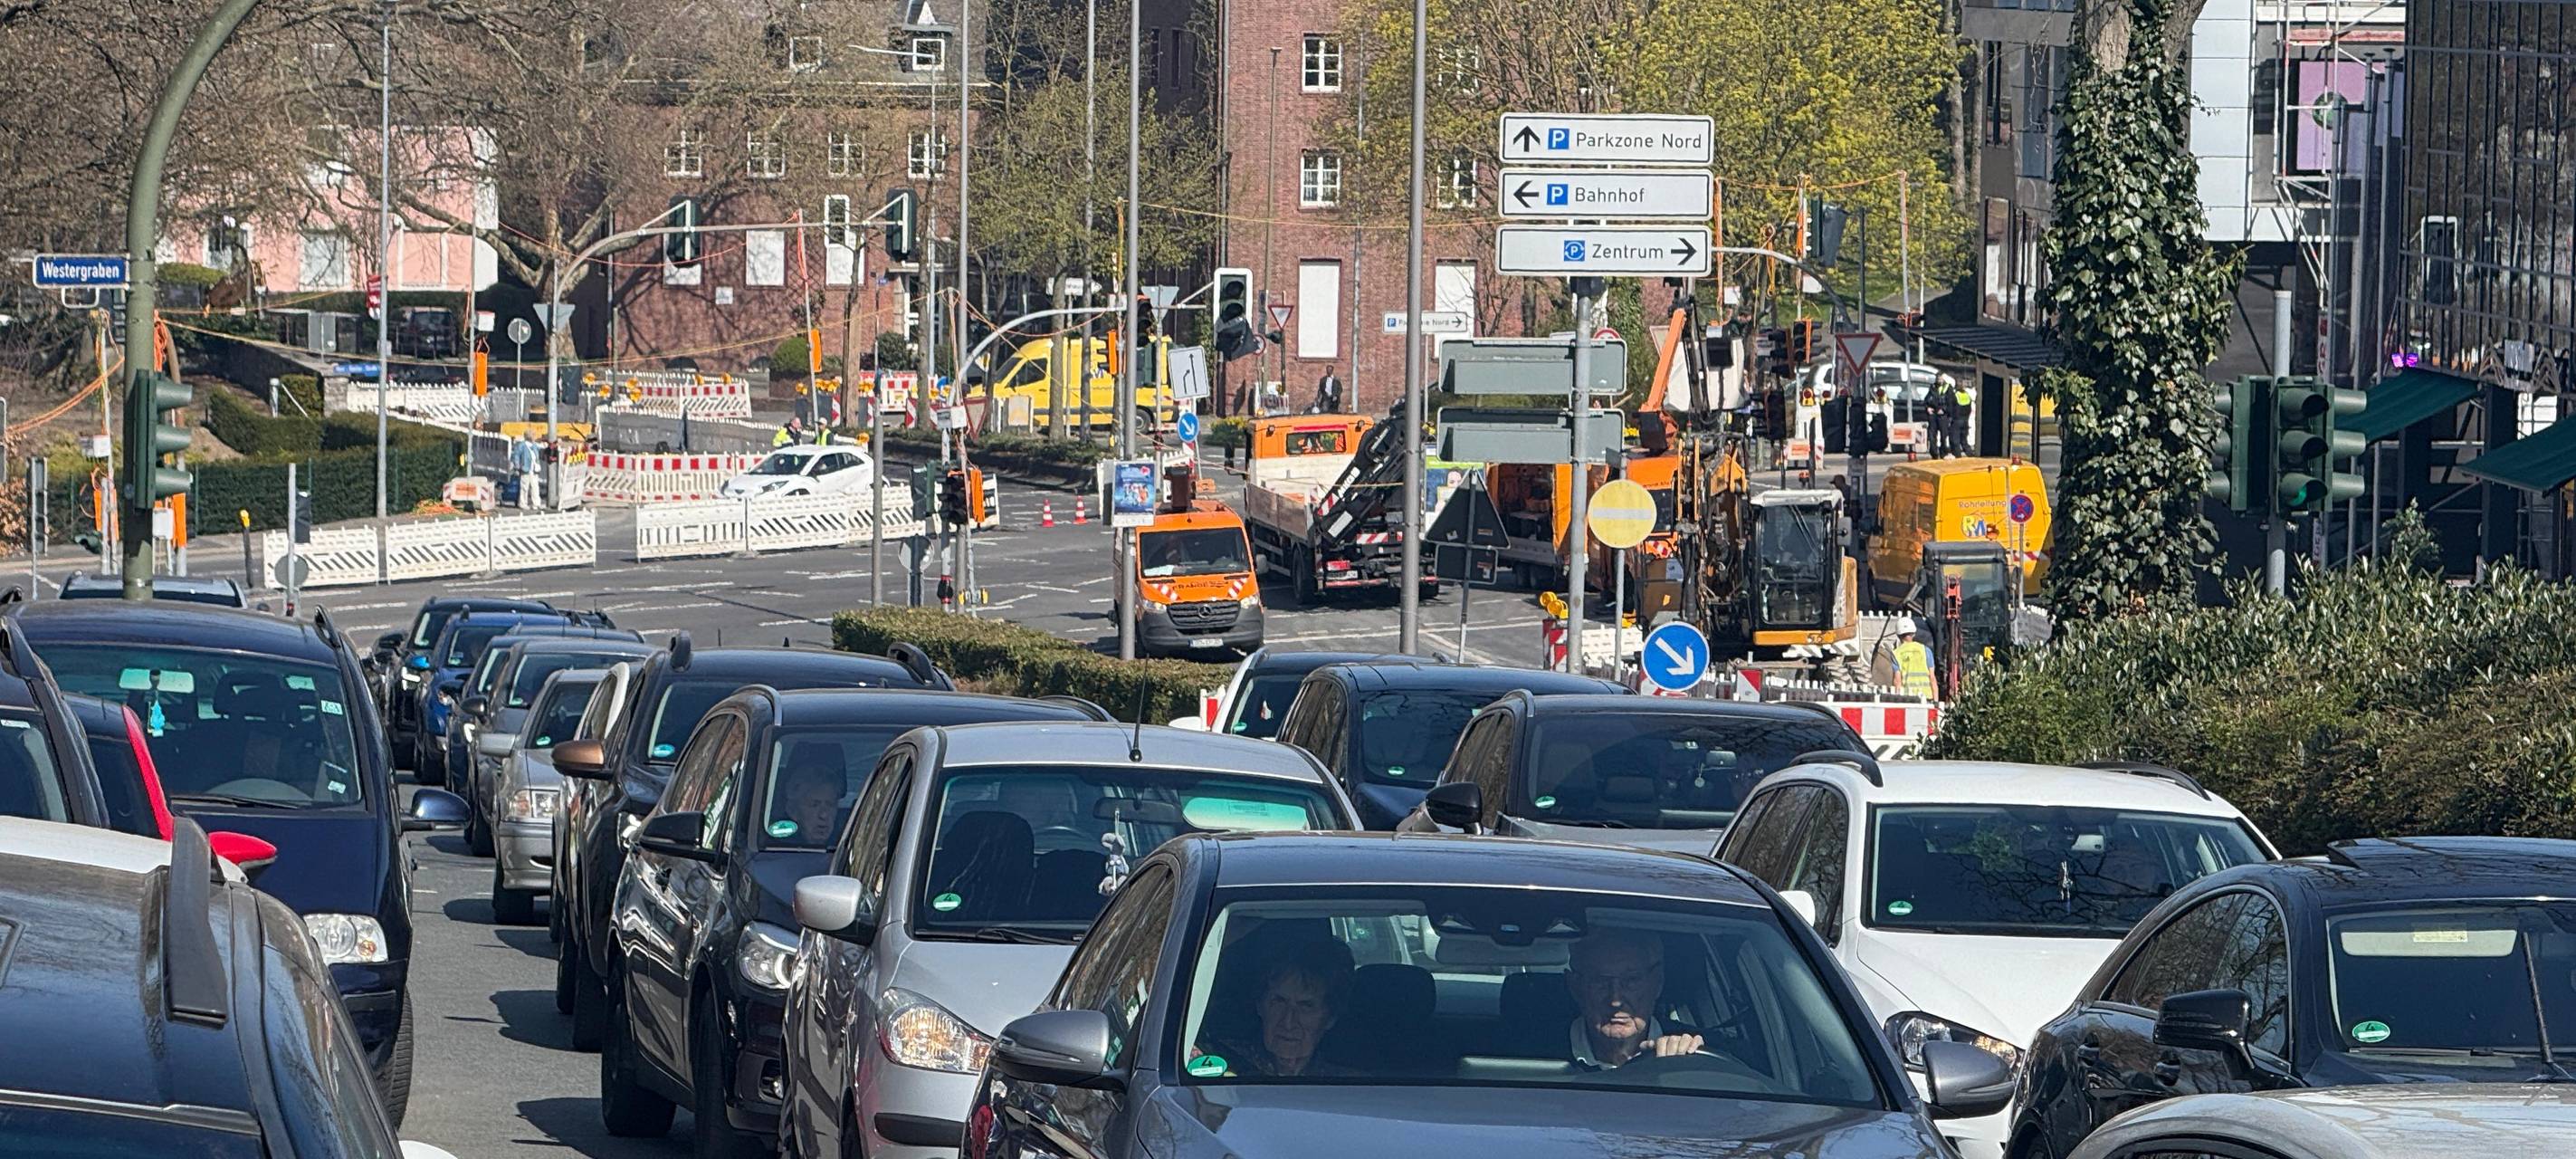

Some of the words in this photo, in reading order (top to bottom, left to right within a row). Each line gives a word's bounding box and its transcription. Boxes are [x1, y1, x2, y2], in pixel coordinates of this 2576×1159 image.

[1576, 132, 1654, 148] Parkzone
[1662, 133, 1702, 148] Nord
[1575, 187, 1645, 203] Bahnhof
[1592, 244, 1664, 259] Zentrum
[42, 261, 119, 282] Westergraben
[2365, 1022, 2376, 1031] 4
[1201, 1056, 1215, 1068] 4
